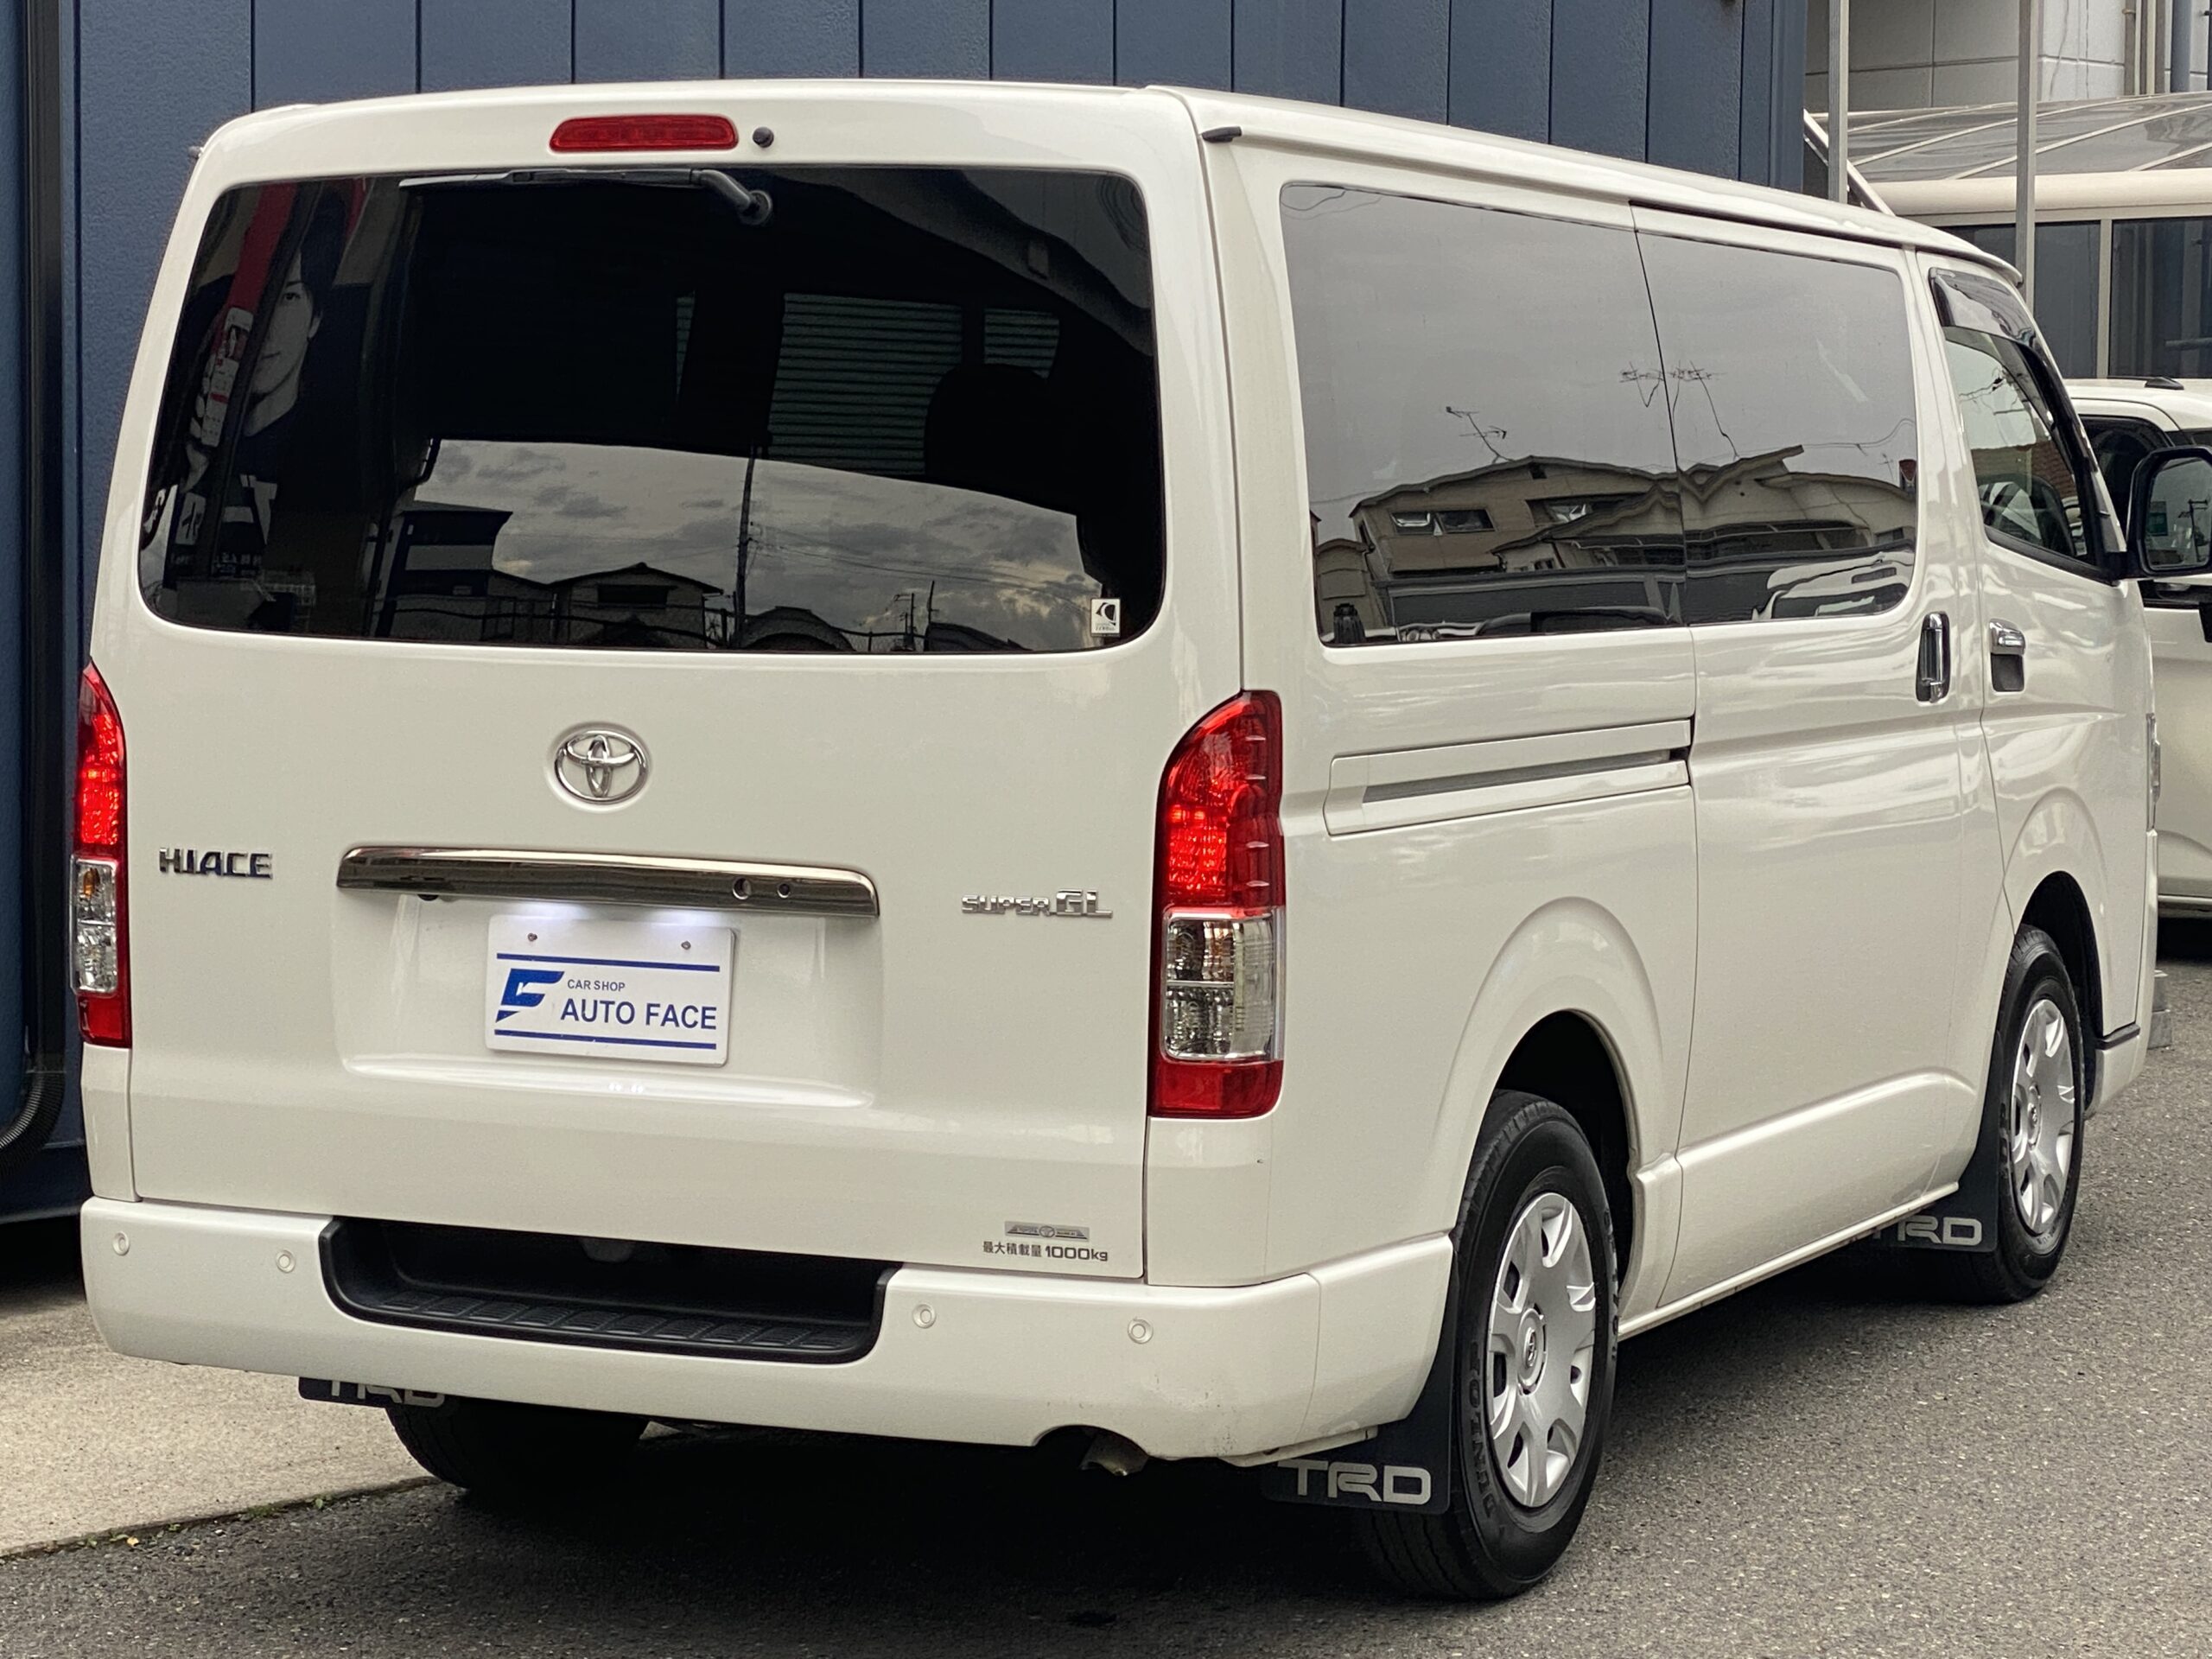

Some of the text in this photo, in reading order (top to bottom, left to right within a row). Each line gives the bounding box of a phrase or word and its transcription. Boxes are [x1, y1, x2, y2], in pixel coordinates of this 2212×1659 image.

[158, 847, 274, 880] HIACE
[961, 893, 1051, 917] SUPER
[567, 978, 626, 992] CAR SHOP
[561, 998, 717, 1030] AUTO FACE
[982, 1241, 1109, 1262] 最大積載量 1000kg
[1277, 1459, 1432, 1505] TRD
